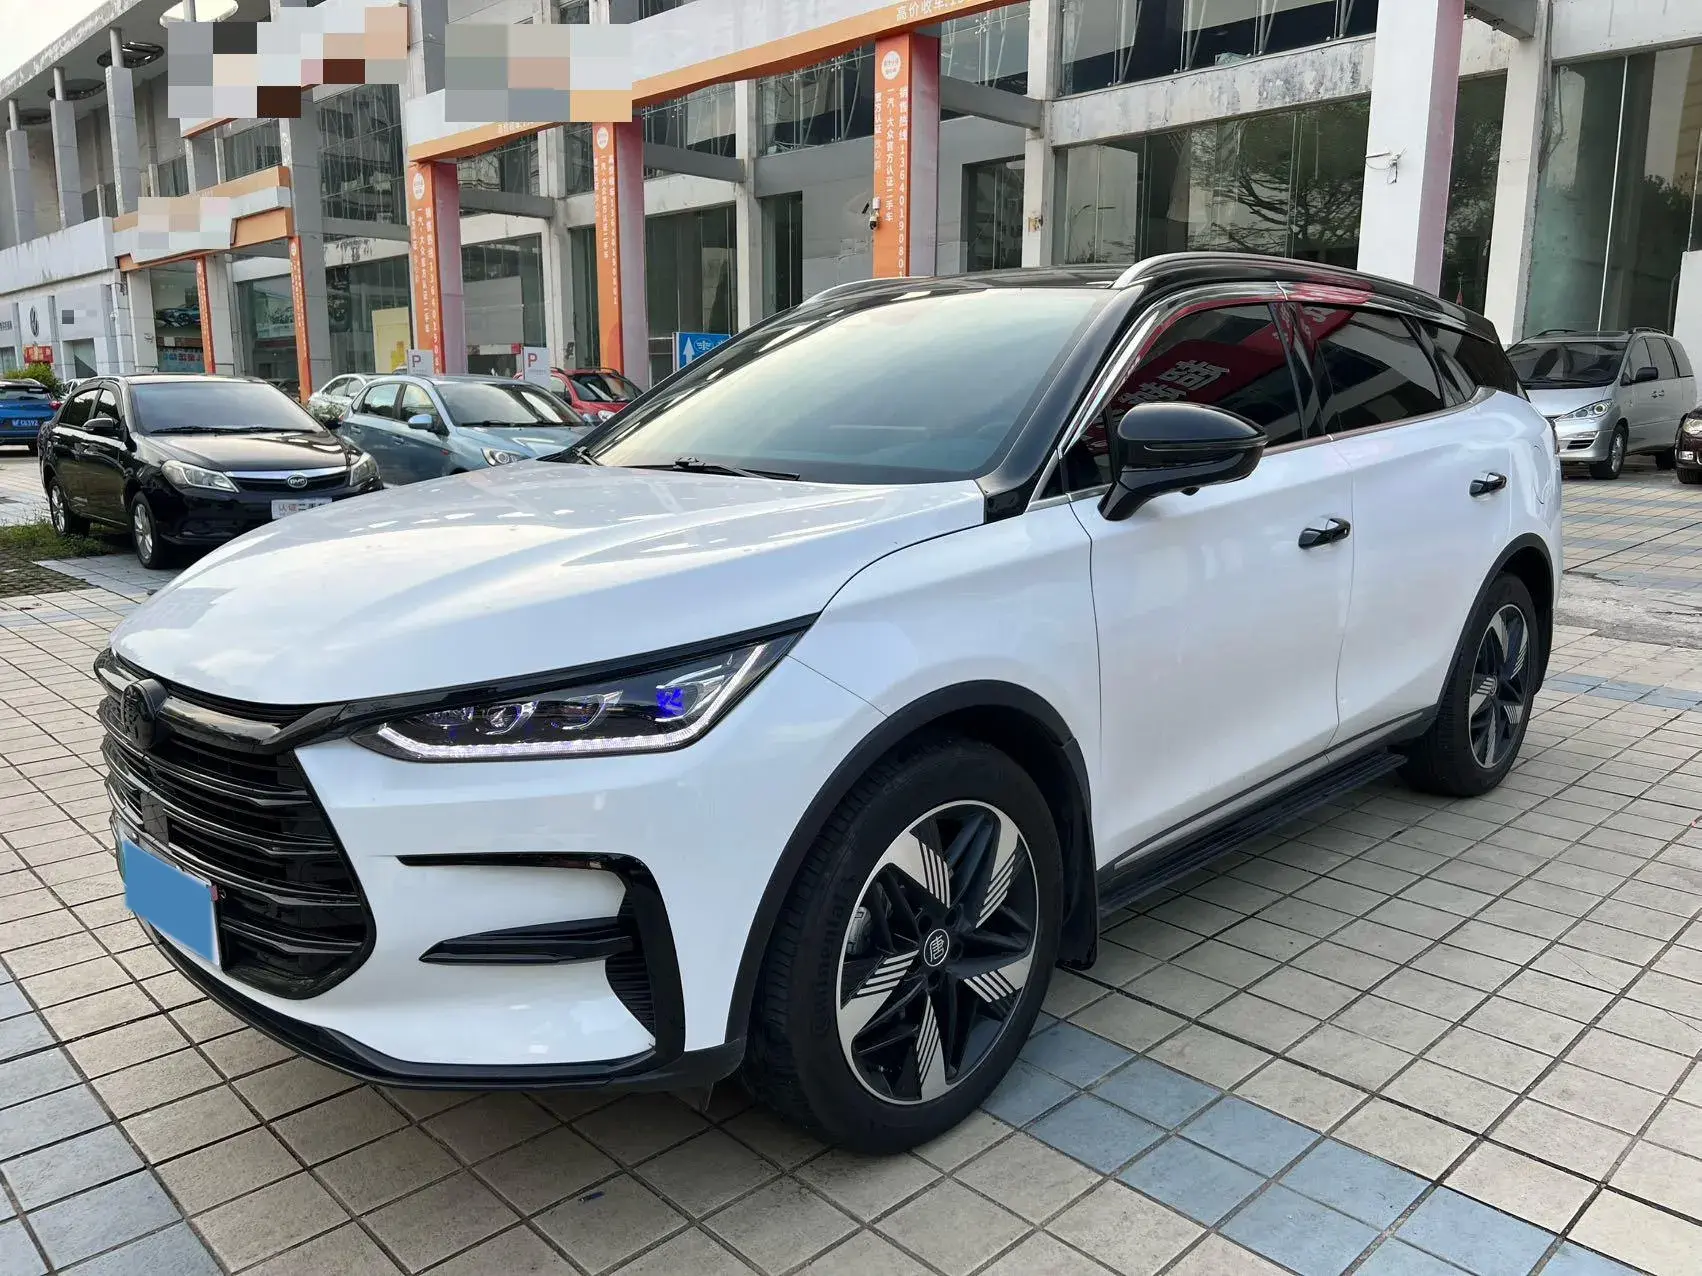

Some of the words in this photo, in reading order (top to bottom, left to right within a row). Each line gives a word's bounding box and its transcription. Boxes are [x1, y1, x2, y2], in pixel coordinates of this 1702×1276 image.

[412, 354, 421, 367] P
[528, 353, 537, 367] P
[930, 935, 945, 962] 唐
